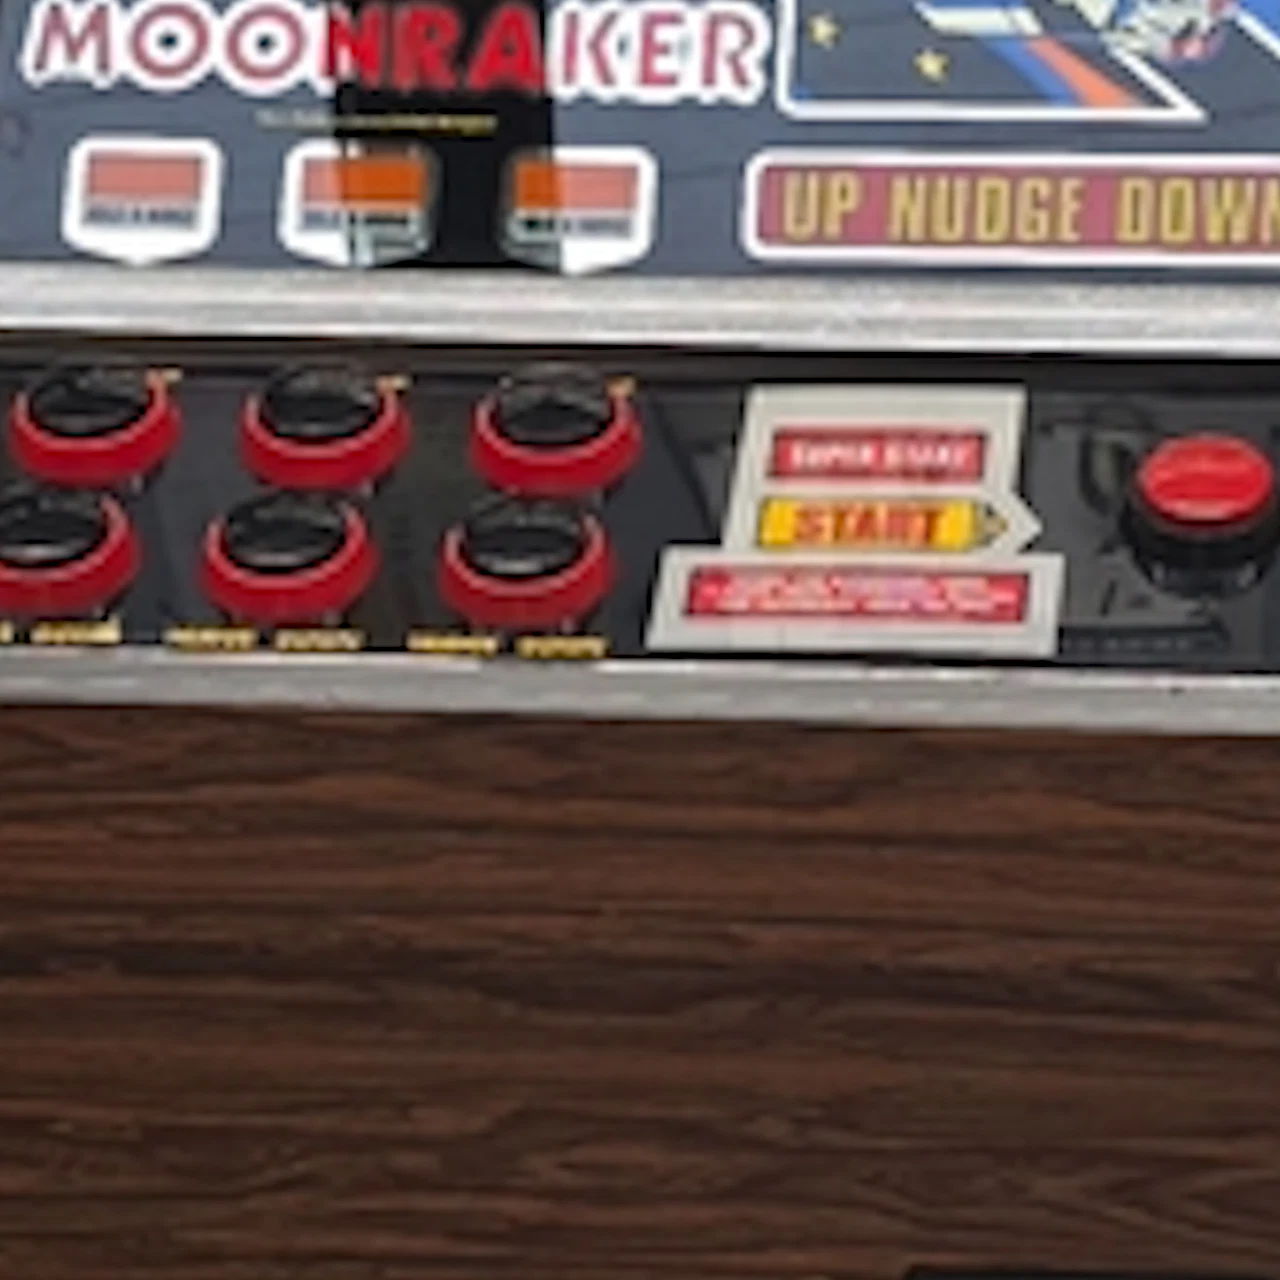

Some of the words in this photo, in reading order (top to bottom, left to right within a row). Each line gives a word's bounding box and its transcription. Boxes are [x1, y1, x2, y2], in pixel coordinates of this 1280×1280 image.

[781, 169, 863, 239] UP
[886, 171, 1086, 243] NUDGE
[792, 503, 948, 546] START
